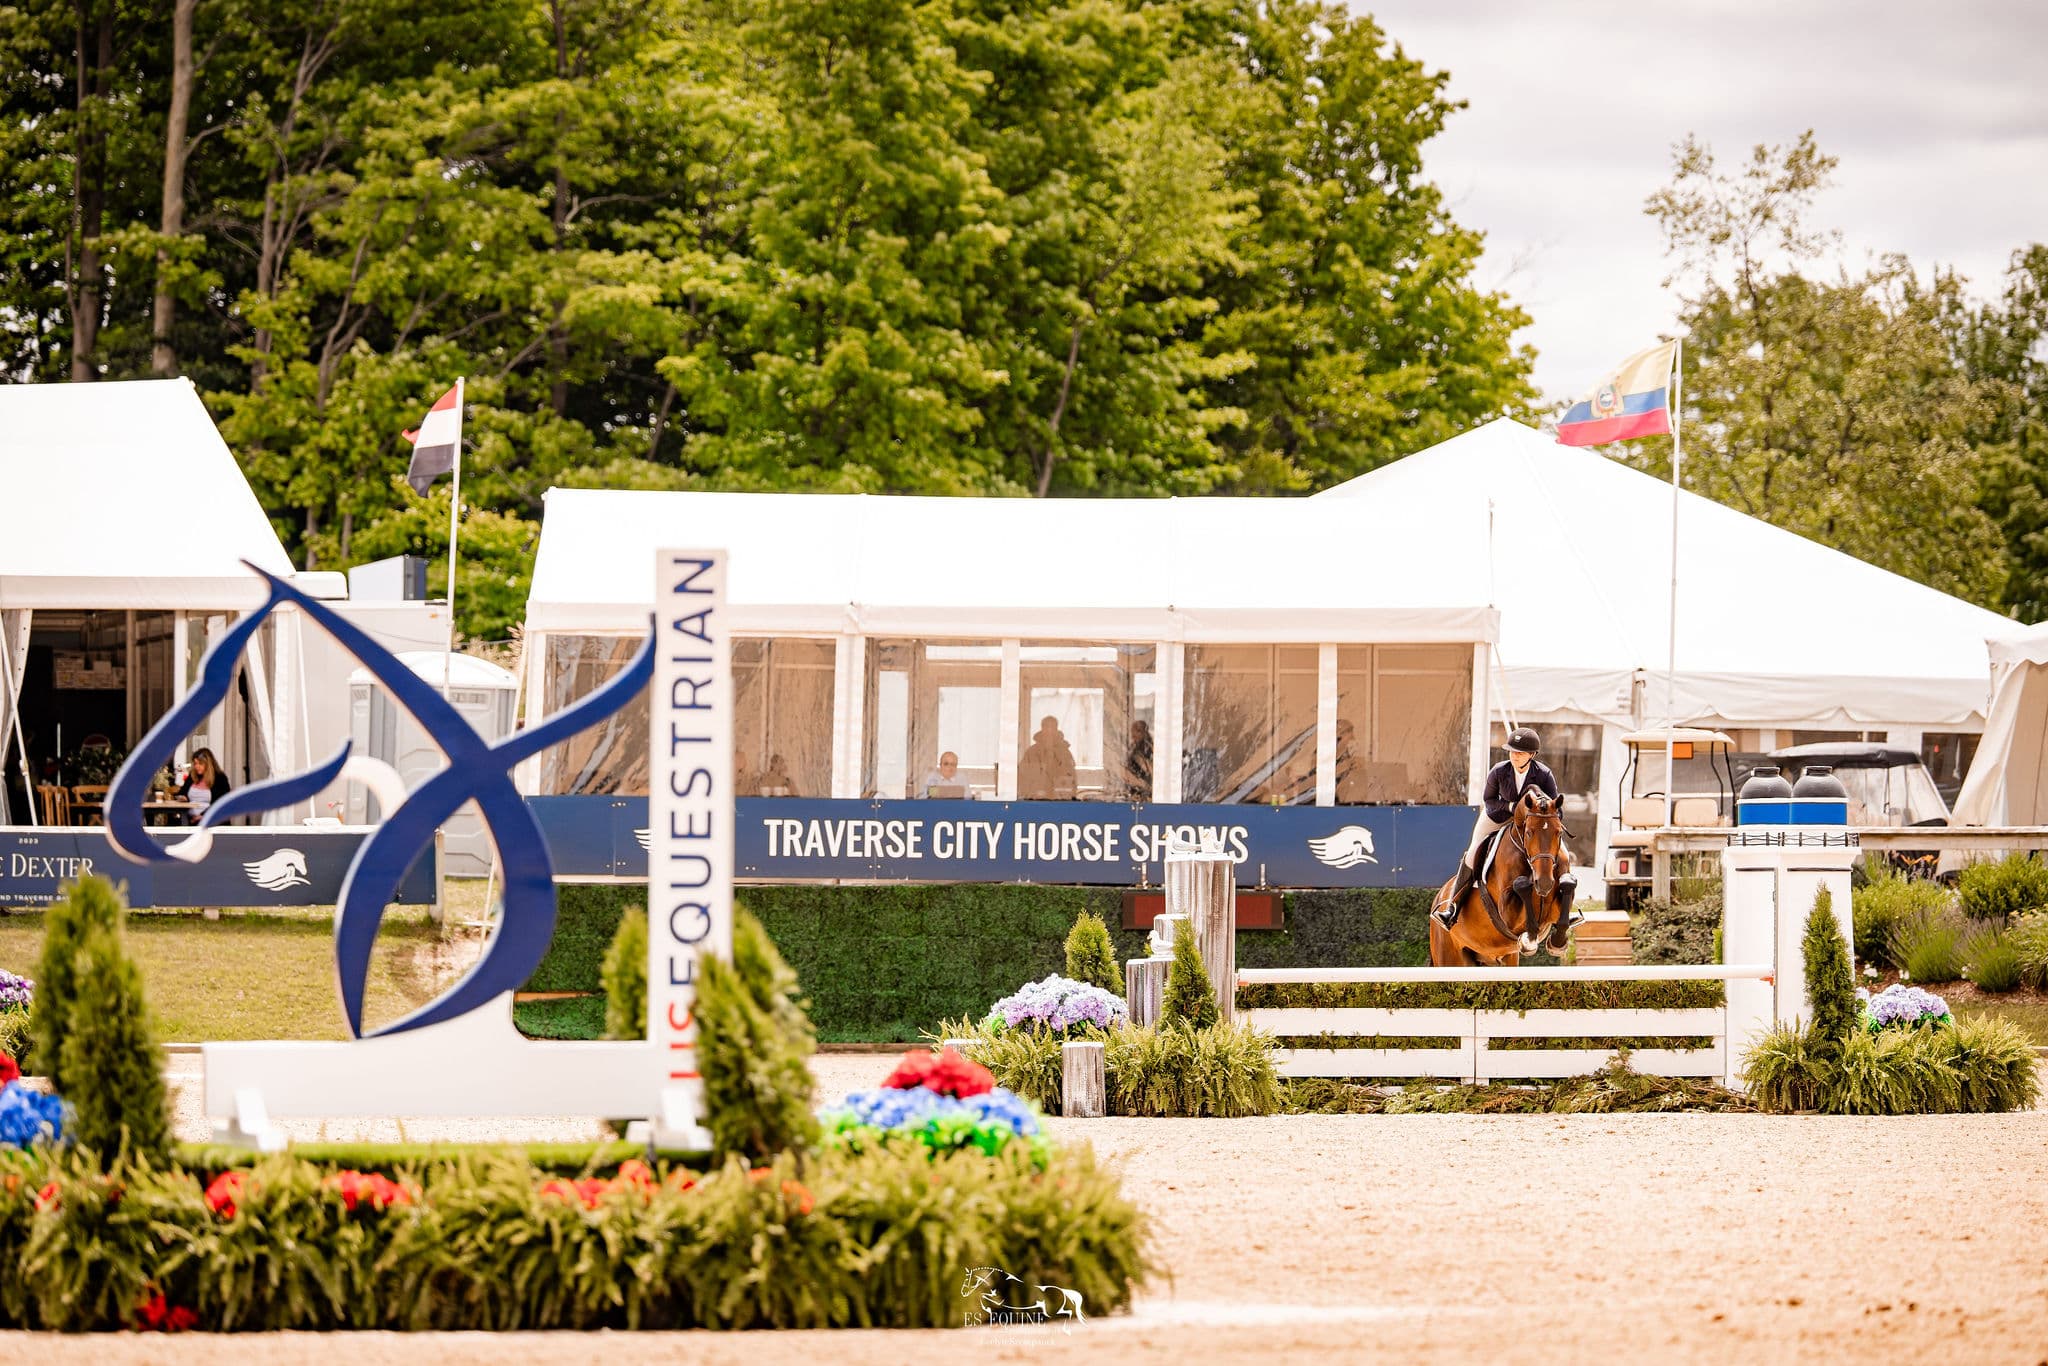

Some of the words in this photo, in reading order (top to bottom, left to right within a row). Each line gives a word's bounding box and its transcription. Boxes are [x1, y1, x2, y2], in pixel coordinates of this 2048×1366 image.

[669, 556, 715, 986] EQUESTRIAN
[763, 819, 923, 857] TRAVERSE
[933, 821, 1004, 858] CITY
[1014, 822, 1120, 861] HORSE
[11, 853, 94, 878] DEXTER
